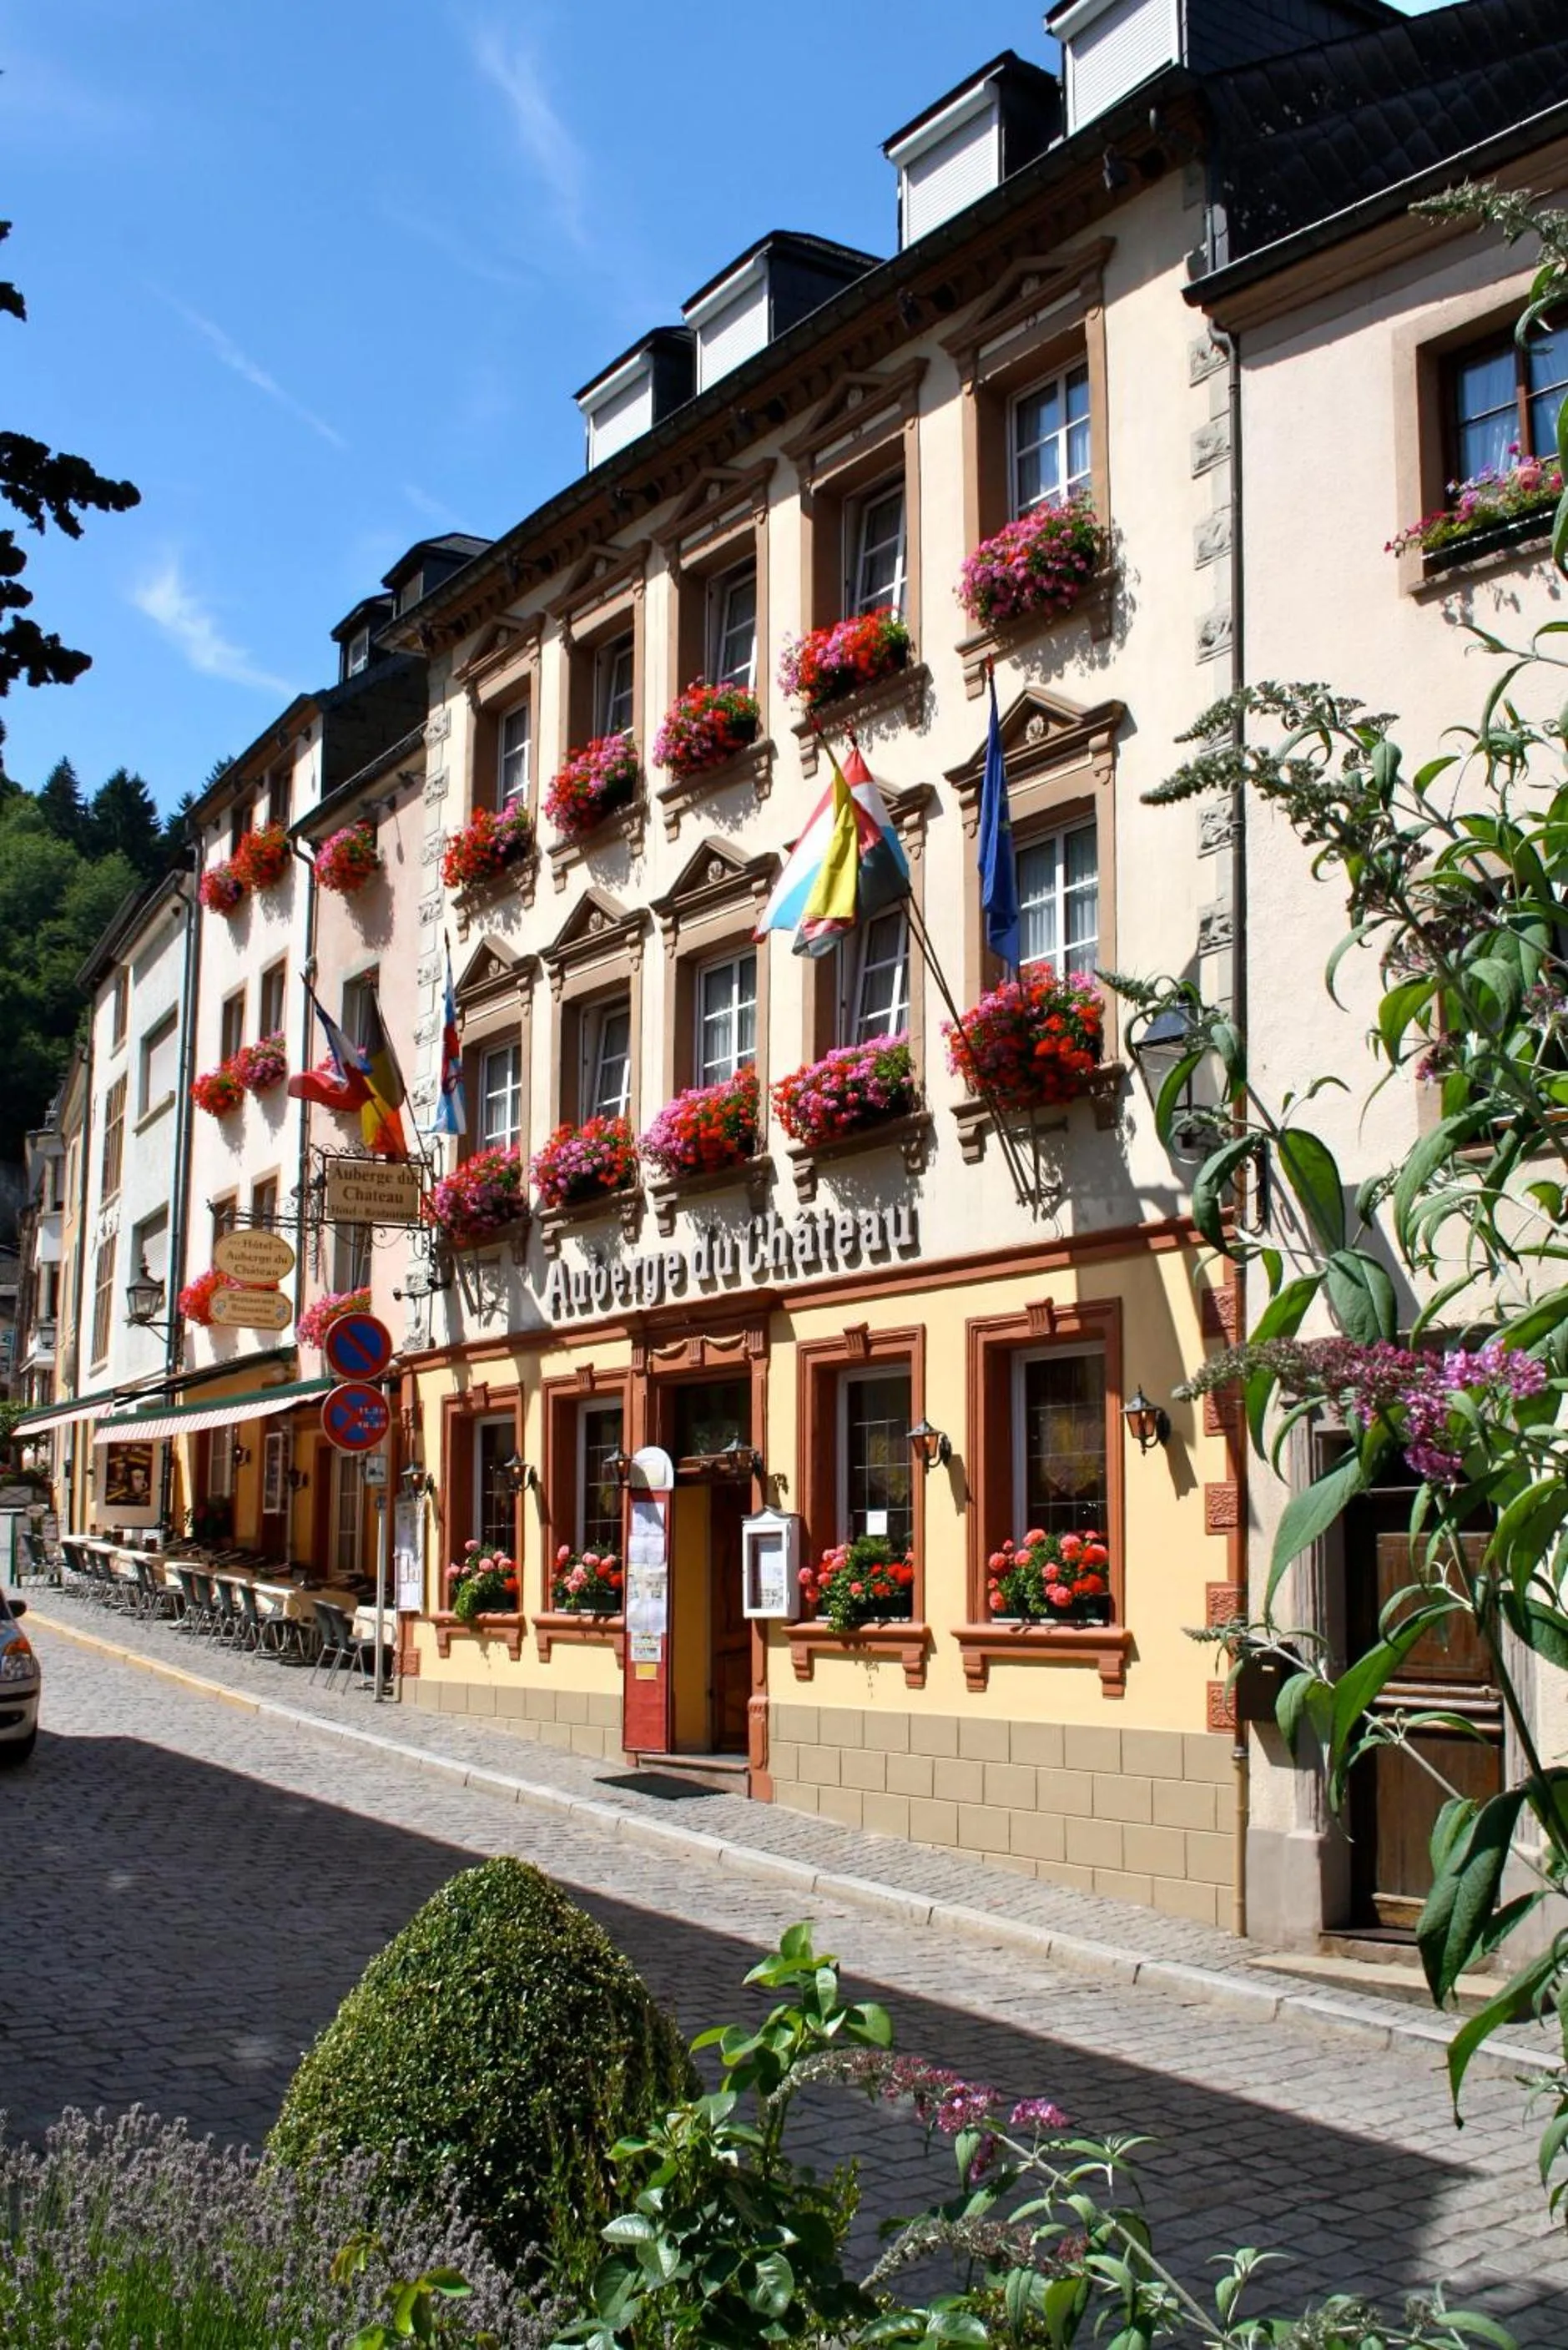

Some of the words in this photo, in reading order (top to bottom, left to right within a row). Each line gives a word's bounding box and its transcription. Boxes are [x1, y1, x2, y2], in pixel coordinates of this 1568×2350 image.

[334, 1167, 392, 1184] Auberge
[397, 1169, 419, 1185] du
[227, 1250, 271, 1264] Auberge
[275, 1254, 288, 1264] du
[545, 1250, 679, 1310] Auberge
[690, 1232, 733, 1281] du
[739, 1204, 914, 1275] Château
